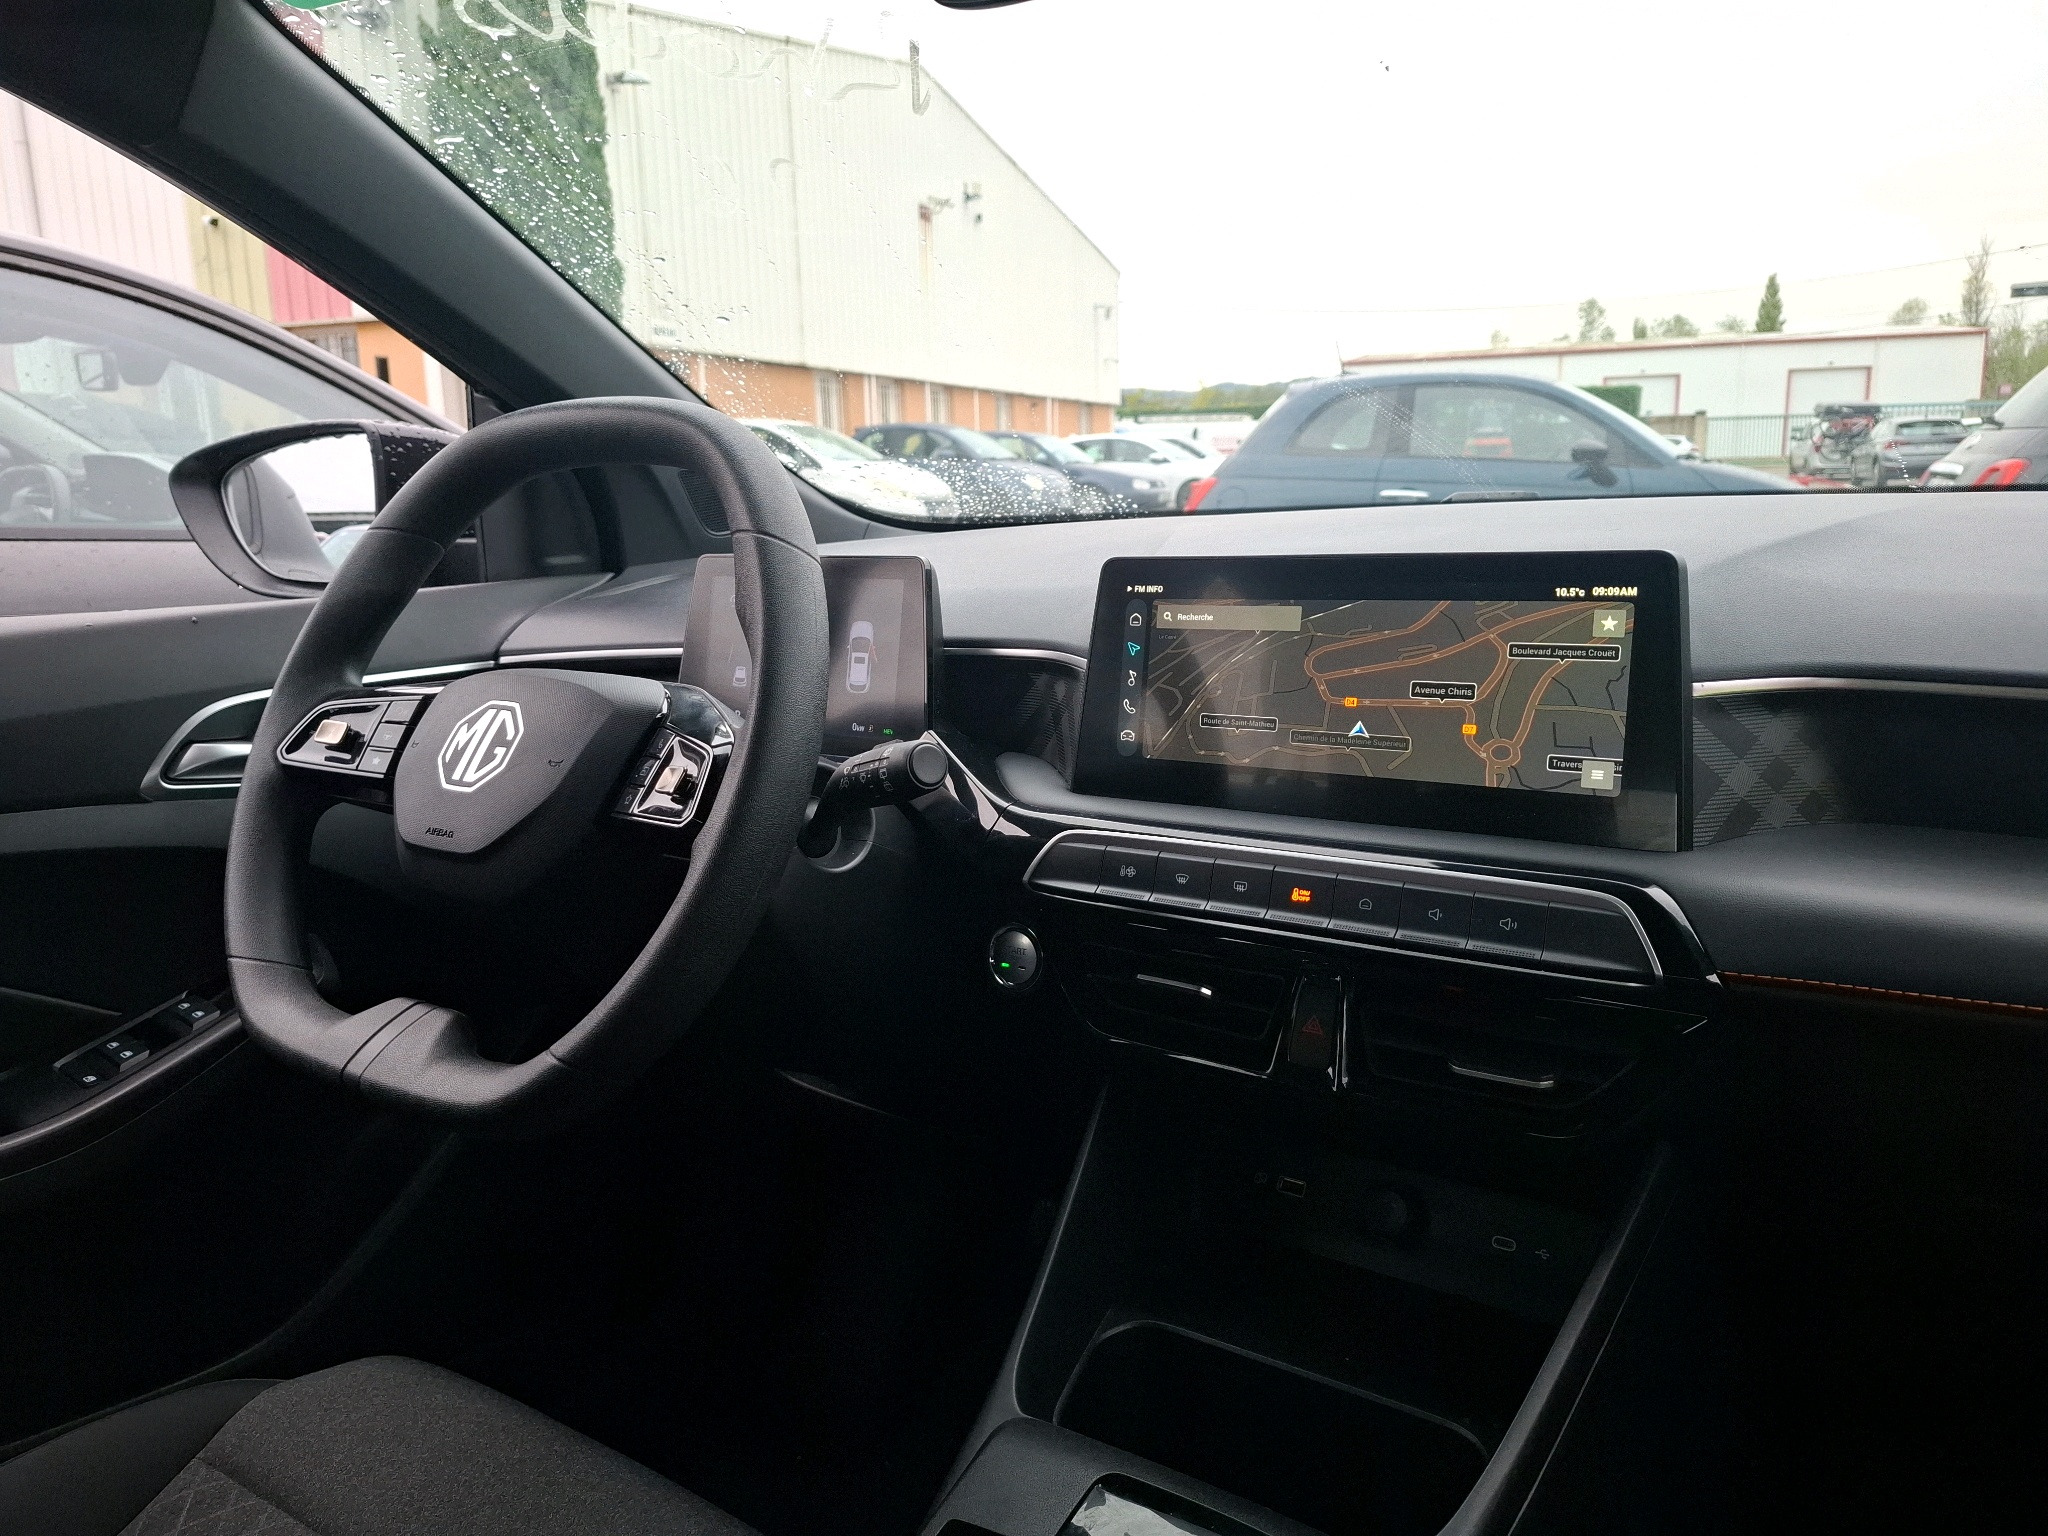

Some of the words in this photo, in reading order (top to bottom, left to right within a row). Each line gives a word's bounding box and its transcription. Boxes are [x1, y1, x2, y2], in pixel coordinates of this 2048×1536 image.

[1134, 585, 1145, 593] FM
[1146, 585, 1164, 593] INFO
[1177, 613, 1214, 621] Recherche
[1512, 647, 1551, 656] Boulevard
[1553, 648, 1586, 658] Jacques
[1414, 686, 1445, 695] Avenue
[1447, 687, 1473, 696] Chiris
[1203, 717, 1221, 725] Route
[1231, 718, 1275, 728] Saint-Mathieu
[445, 707, 516, 783] MG
[1293, 733, 1319, 742] Chemin
[1320, 734, 1328, 743] de
[1329, 735, 1336, 743] la
[1337, 736, 1371, 746] Madeleine
[425, 827, 455, 839] AIRBAG
